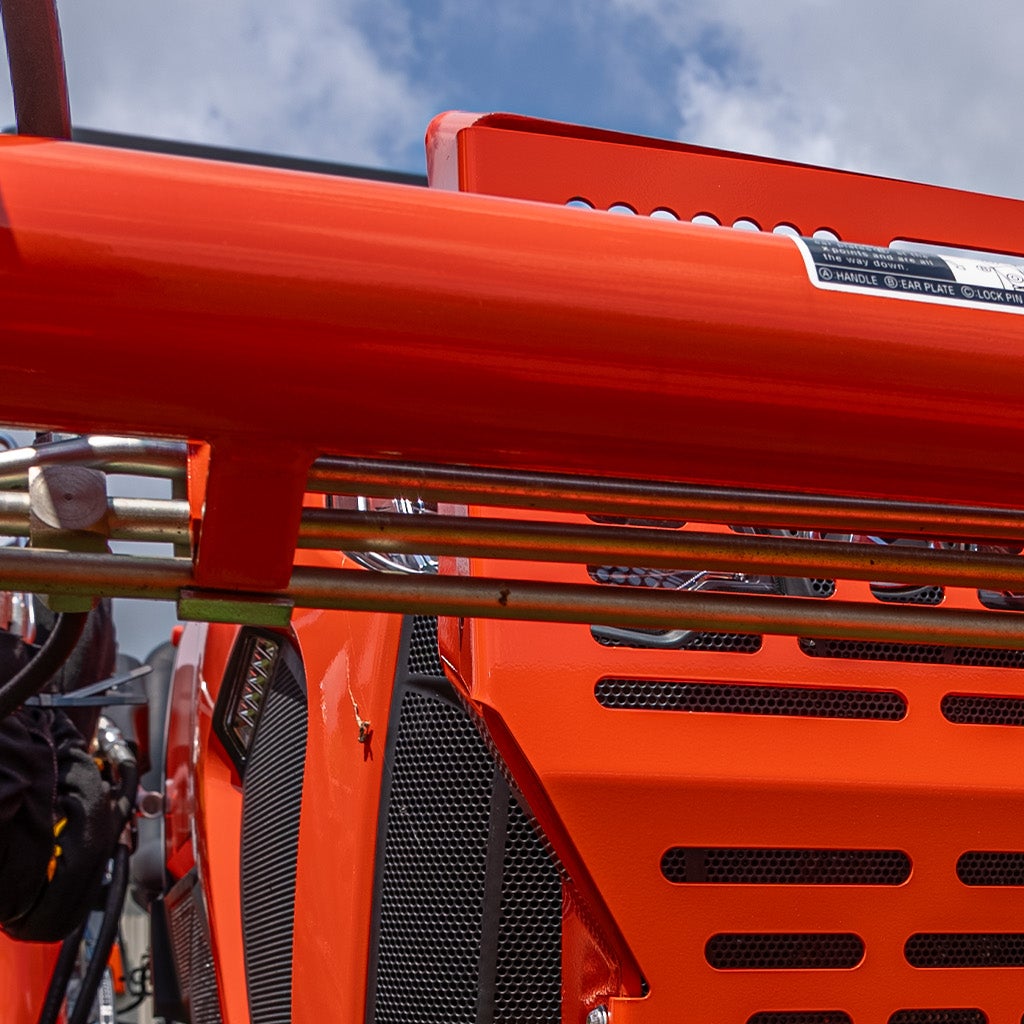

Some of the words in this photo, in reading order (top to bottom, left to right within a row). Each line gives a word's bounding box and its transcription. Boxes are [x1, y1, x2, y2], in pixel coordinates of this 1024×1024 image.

[822, 253, 842, 262] the
[846, 257, 869, 267] way
[873, 260, 909, 272] down.
[832, 248, 869, 258] points
[872, 253, 894, 261] and
[898, 257, 916, 265] are
[925, 282, 955, 296] PLATE
[1006, 293, 1024, 305] PIN
